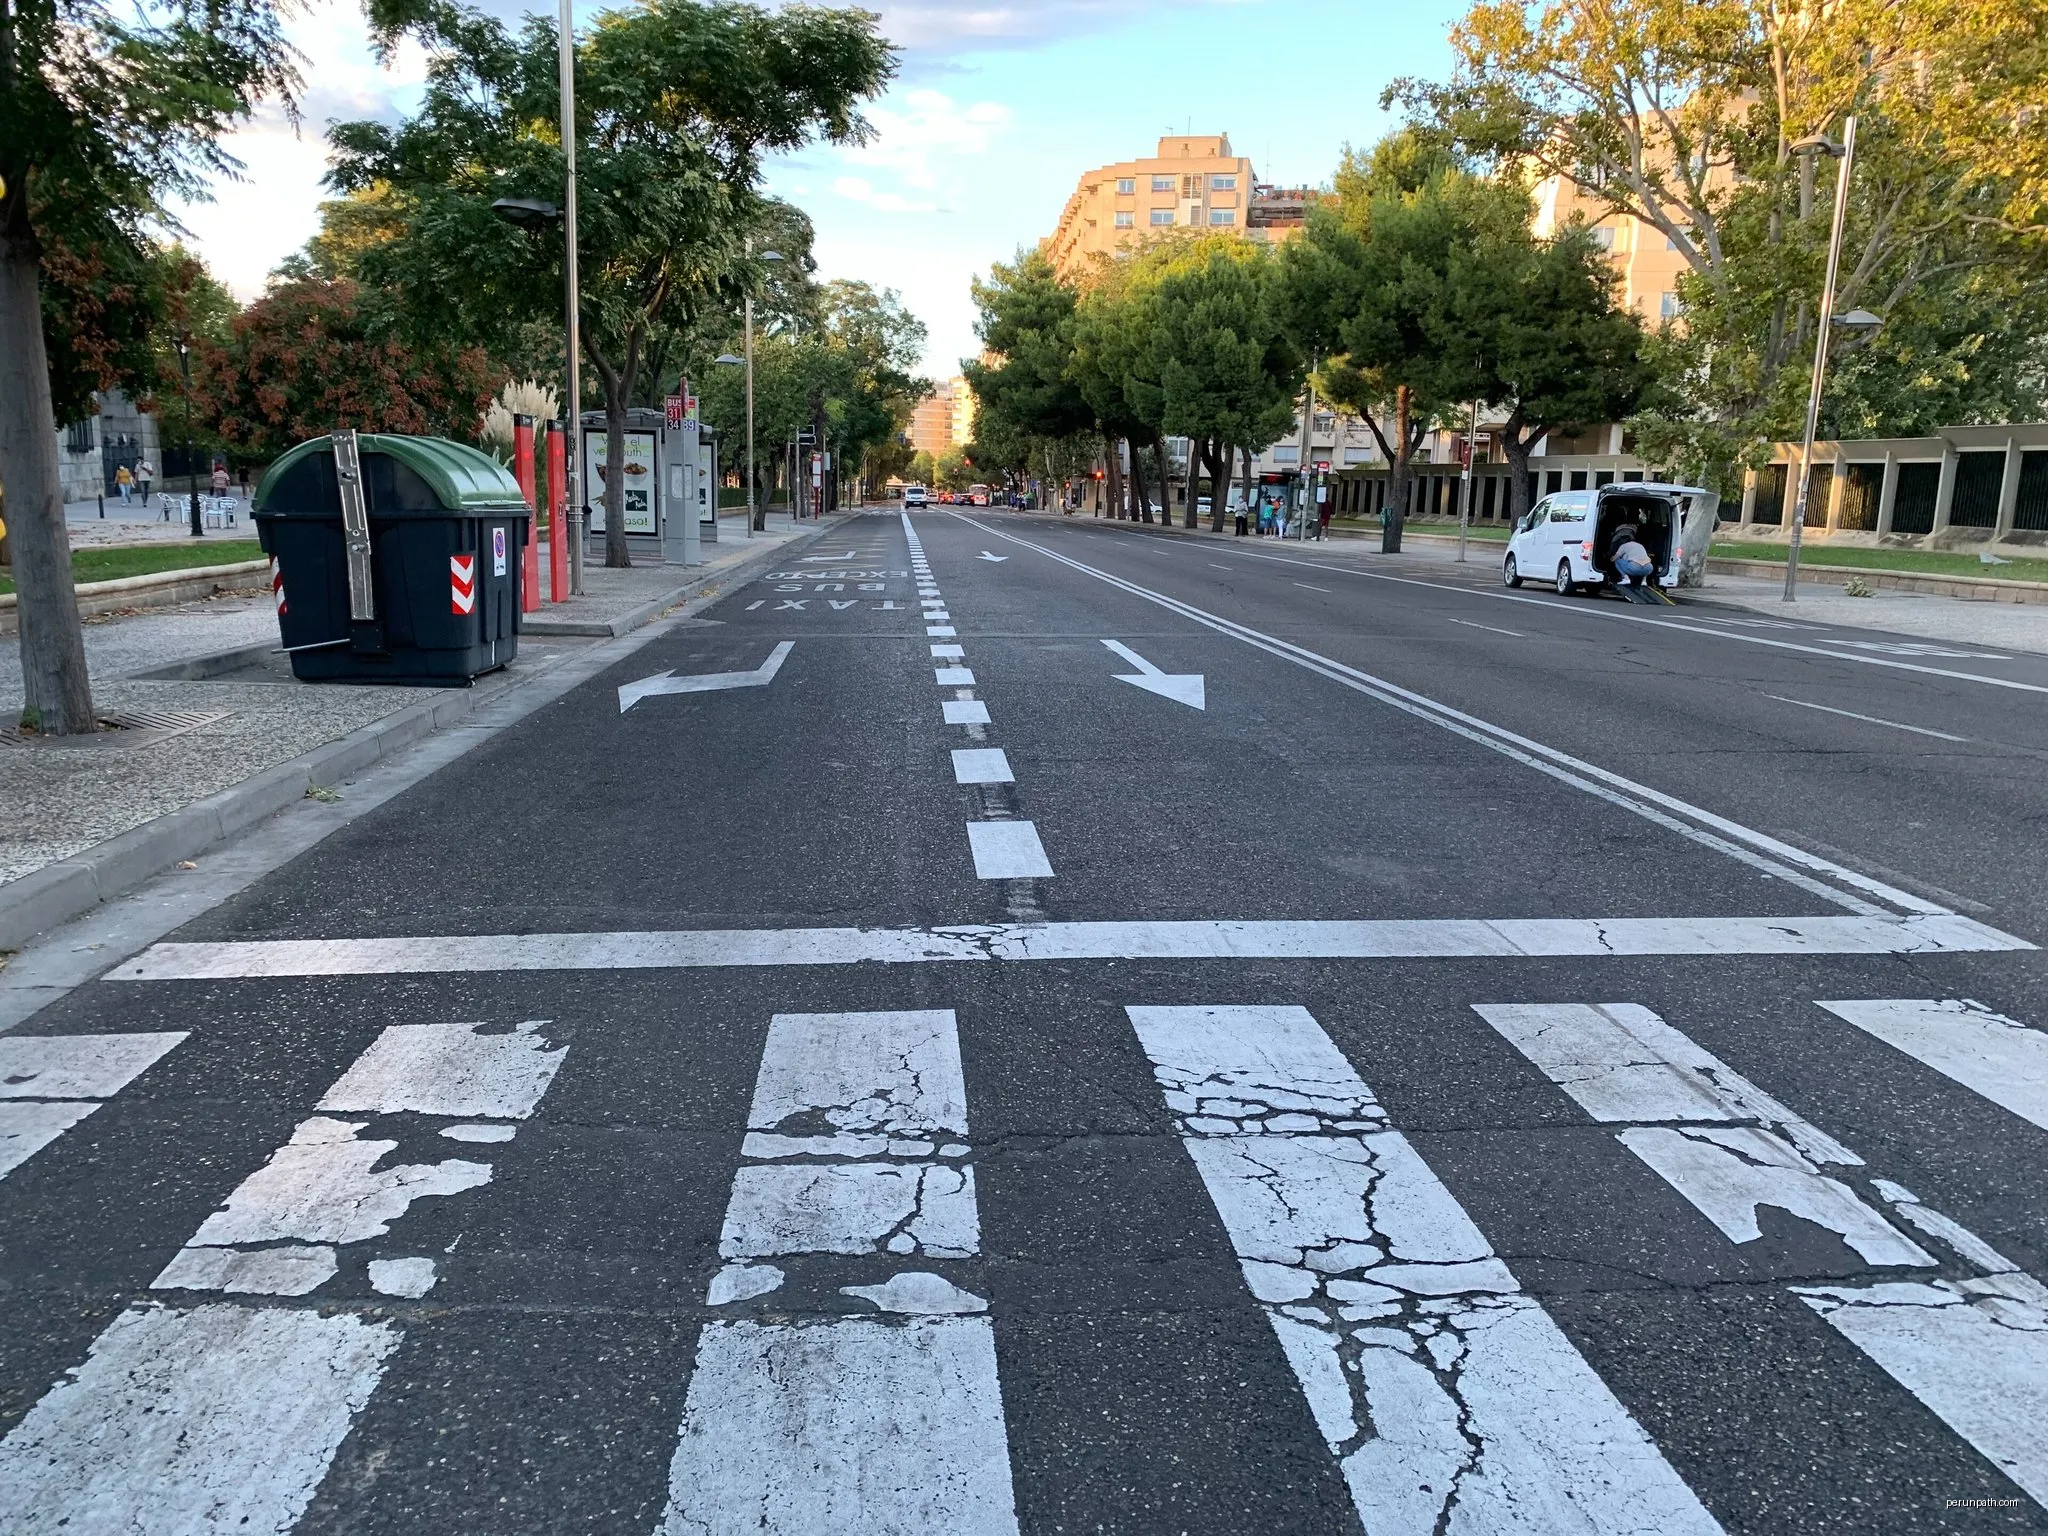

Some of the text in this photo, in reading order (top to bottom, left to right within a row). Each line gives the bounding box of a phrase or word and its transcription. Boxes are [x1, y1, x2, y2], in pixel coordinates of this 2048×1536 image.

[667, 398, 682, 407] BUS
[668, 408, 678, 418] 31
[668, 419, 679, 430] 34
[630, 436, 640, 446] el
[624, 517, 648, 526] asa!
[764, 570, 908, 580] EXCEPTO
[773, 582, 886, 592] BUS
[744, 599, 906, 611] TAXI
